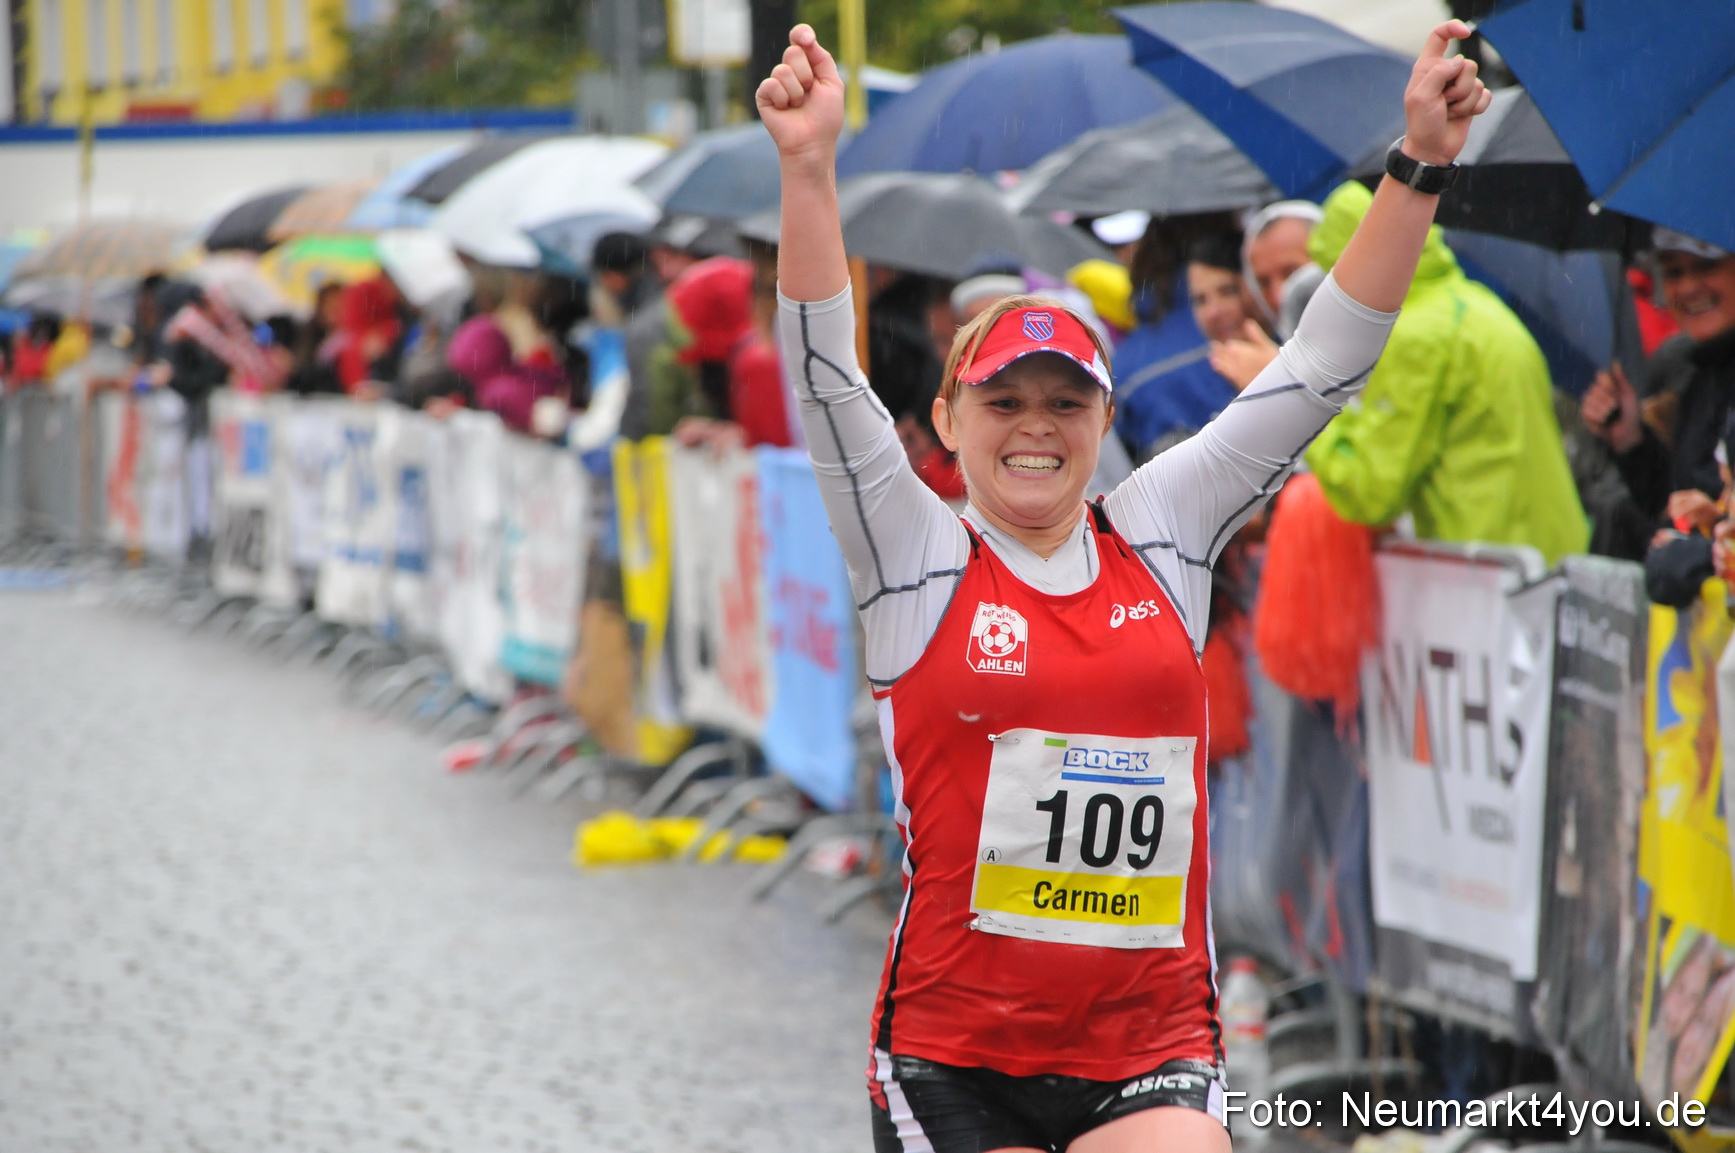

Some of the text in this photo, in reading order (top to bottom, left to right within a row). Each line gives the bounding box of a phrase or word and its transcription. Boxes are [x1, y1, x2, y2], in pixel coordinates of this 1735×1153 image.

[977, 658, 1023, 672] AHLEN
[1063, 747, 1150, 772] BOCK
[1035, 789, 1165, 870] 109
[986, 849, 998, 863] A
[1033, 880, 1140, 916] Carmen
